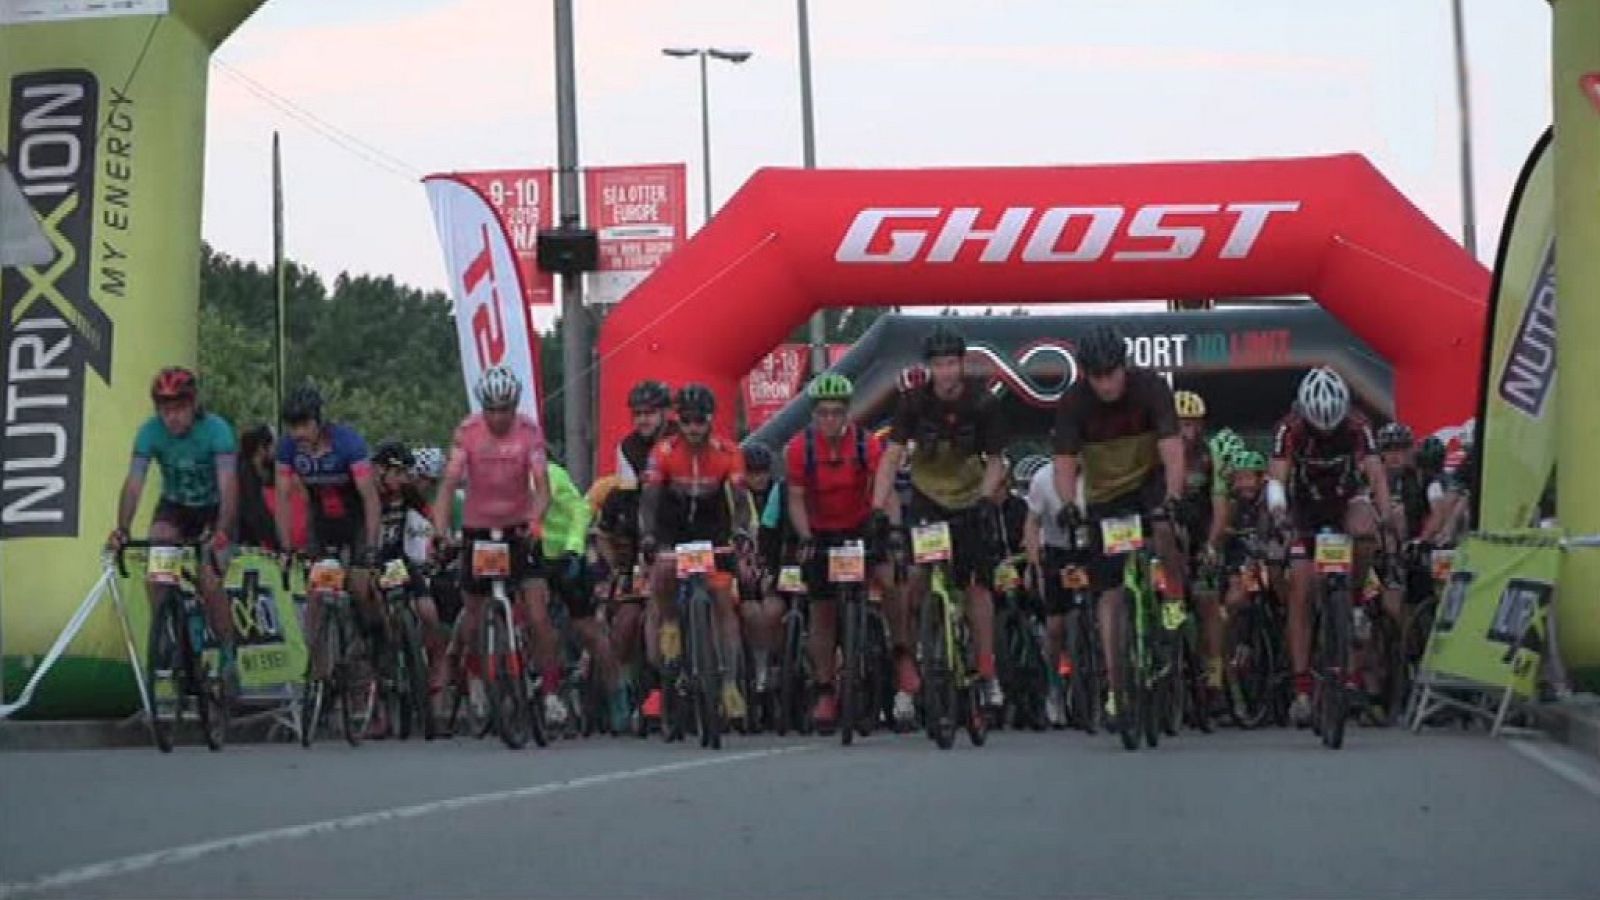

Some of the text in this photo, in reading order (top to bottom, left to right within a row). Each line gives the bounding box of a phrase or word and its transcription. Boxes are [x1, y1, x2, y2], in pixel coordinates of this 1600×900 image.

[100, 87, 134, 298] MY ENERGY
[603, 183, 667, 205] SEA OTTER
[613, 204, 658, 224] EUROPE
[835, 201, 1300, 263] GHOST
[2, 82, 86, 524] NUTRIXXION
[1122, 334, 1188, 367] PORT
[750, 381, 792, 404] GIRON
